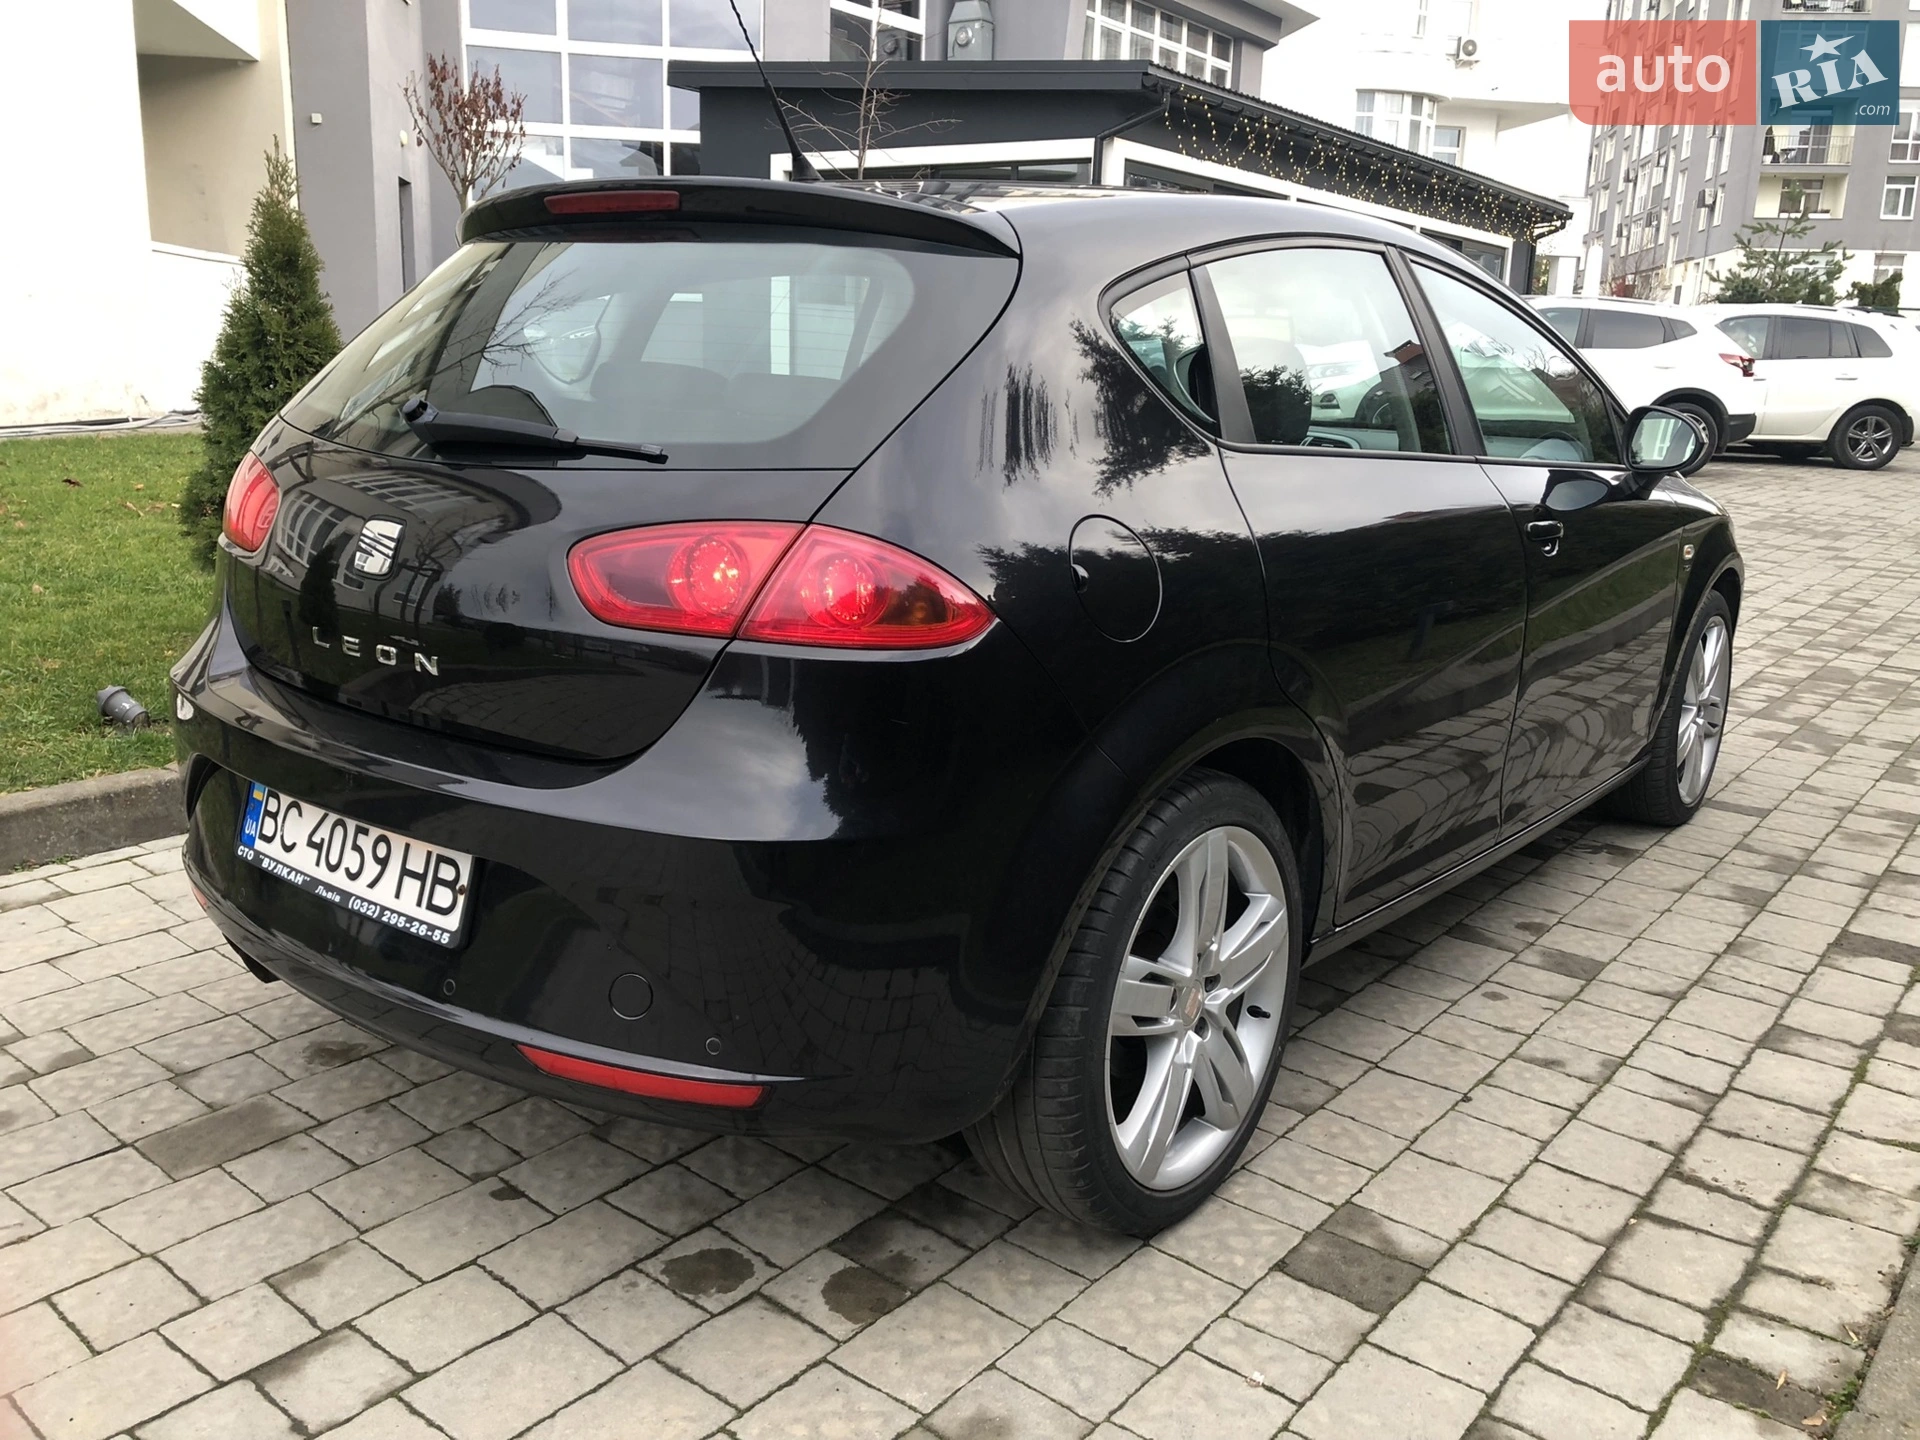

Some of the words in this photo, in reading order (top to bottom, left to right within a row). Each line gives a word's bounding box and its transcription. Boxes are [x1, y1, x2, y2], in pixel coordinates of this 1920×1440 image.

[312, 626, 439, 676] LEON
[245, 819, 256, 837] UA
[258, 791, 302, 853] BC
[306, 812, 392, 889] 4059
[394, 842, 461, 917] HB
[237, 845, 254, 861] СТО
[348, 895, 380, 918] (032)
[381, 911, 451, 944] 295-26-55
